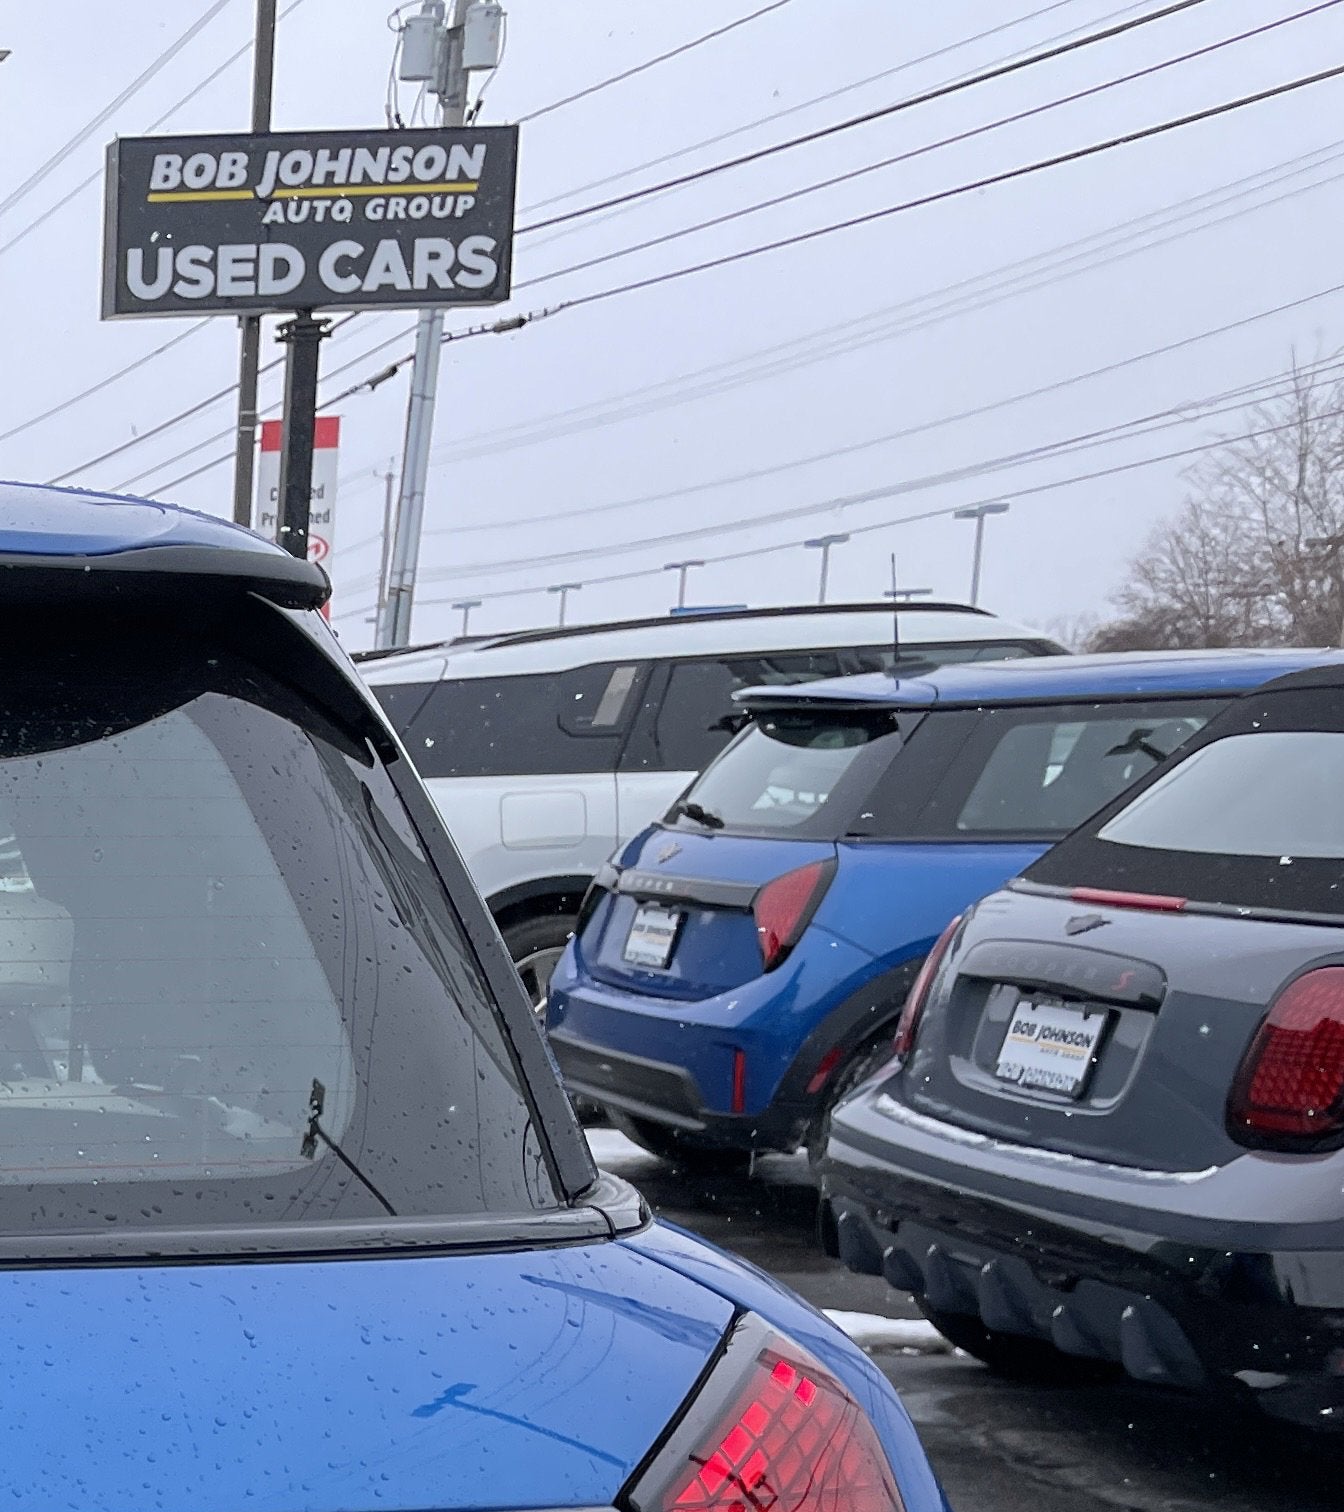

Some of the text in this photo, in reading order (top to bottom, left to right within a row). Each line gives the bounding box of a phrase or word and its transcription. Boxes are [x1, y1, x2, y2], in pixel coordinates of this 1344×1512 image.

[149, 144, 486, 198] BOB JOHNSON
[262, 195, 475, 225] AUTO GROUP
[126, 235, 497, 300] USED CARS
[1110, 971, 1135, 992] S
[1012, 1020, 1094, 1048] BOB JOHNSON
